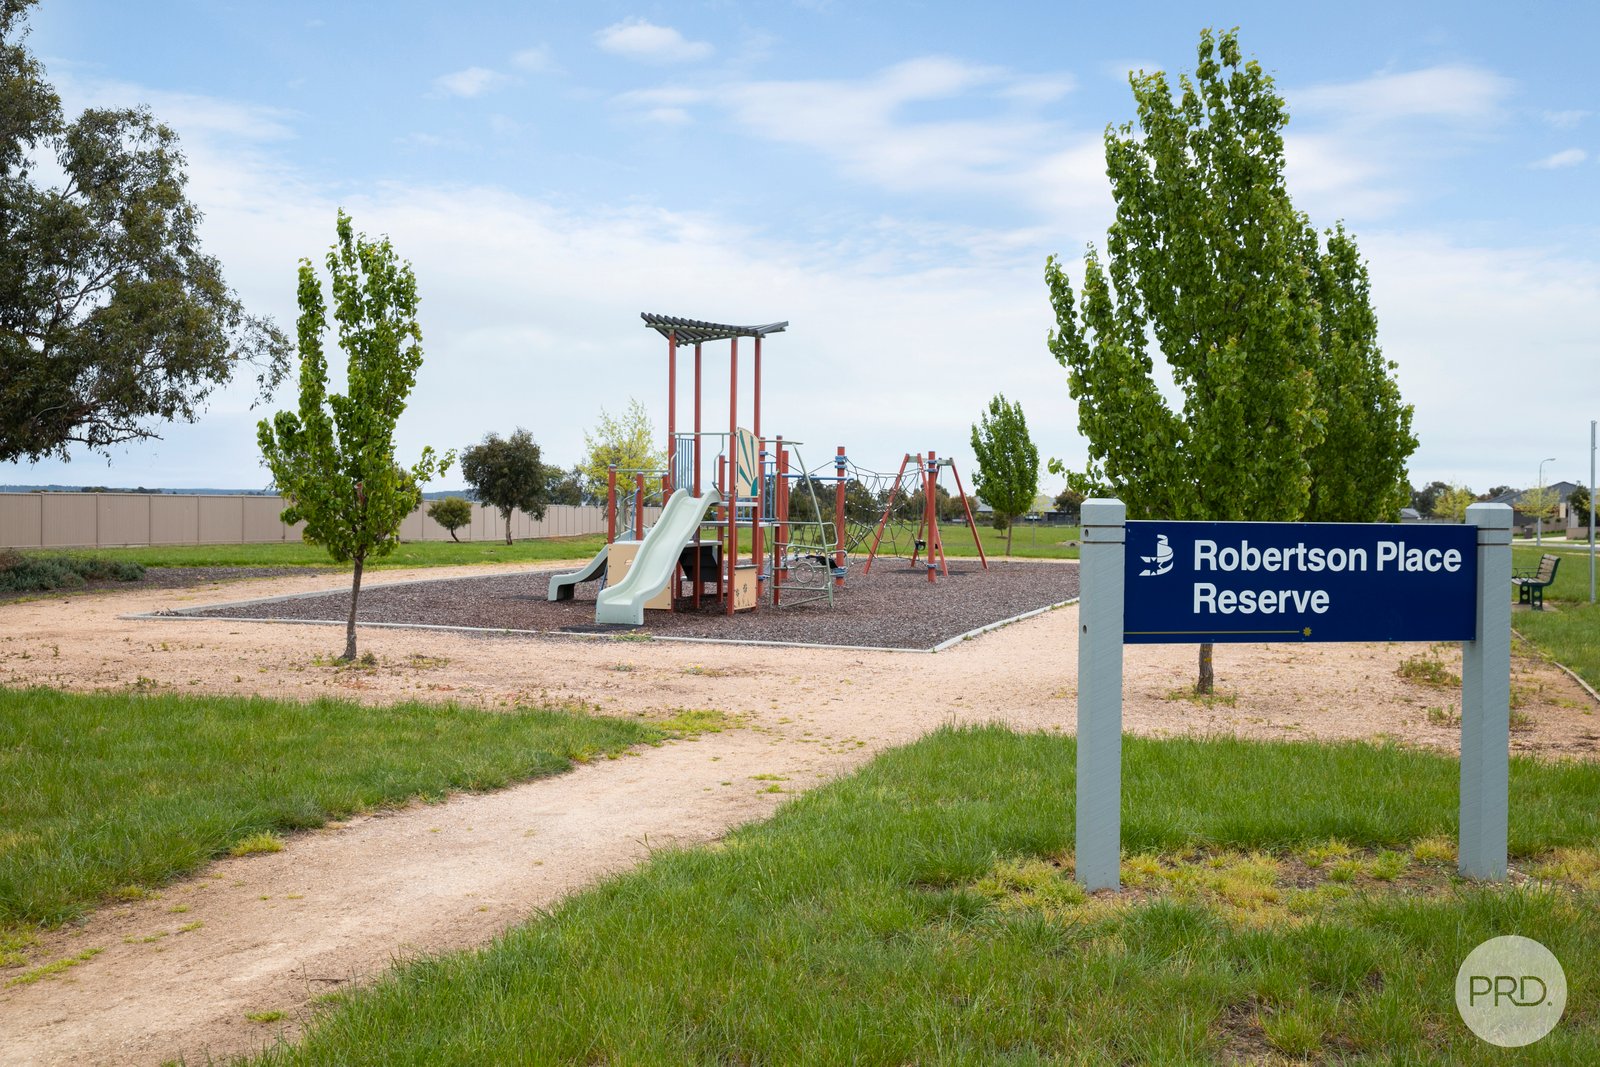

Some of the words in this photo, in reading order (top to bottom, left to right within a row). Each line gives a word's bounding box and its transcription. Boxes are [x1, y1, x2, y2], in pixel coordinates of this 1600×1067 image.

[1193, 539, 1367, 572] Robertson
[1376, 540, 1462, 573] Place
[1193, 582, 1330, 614] Reserve
